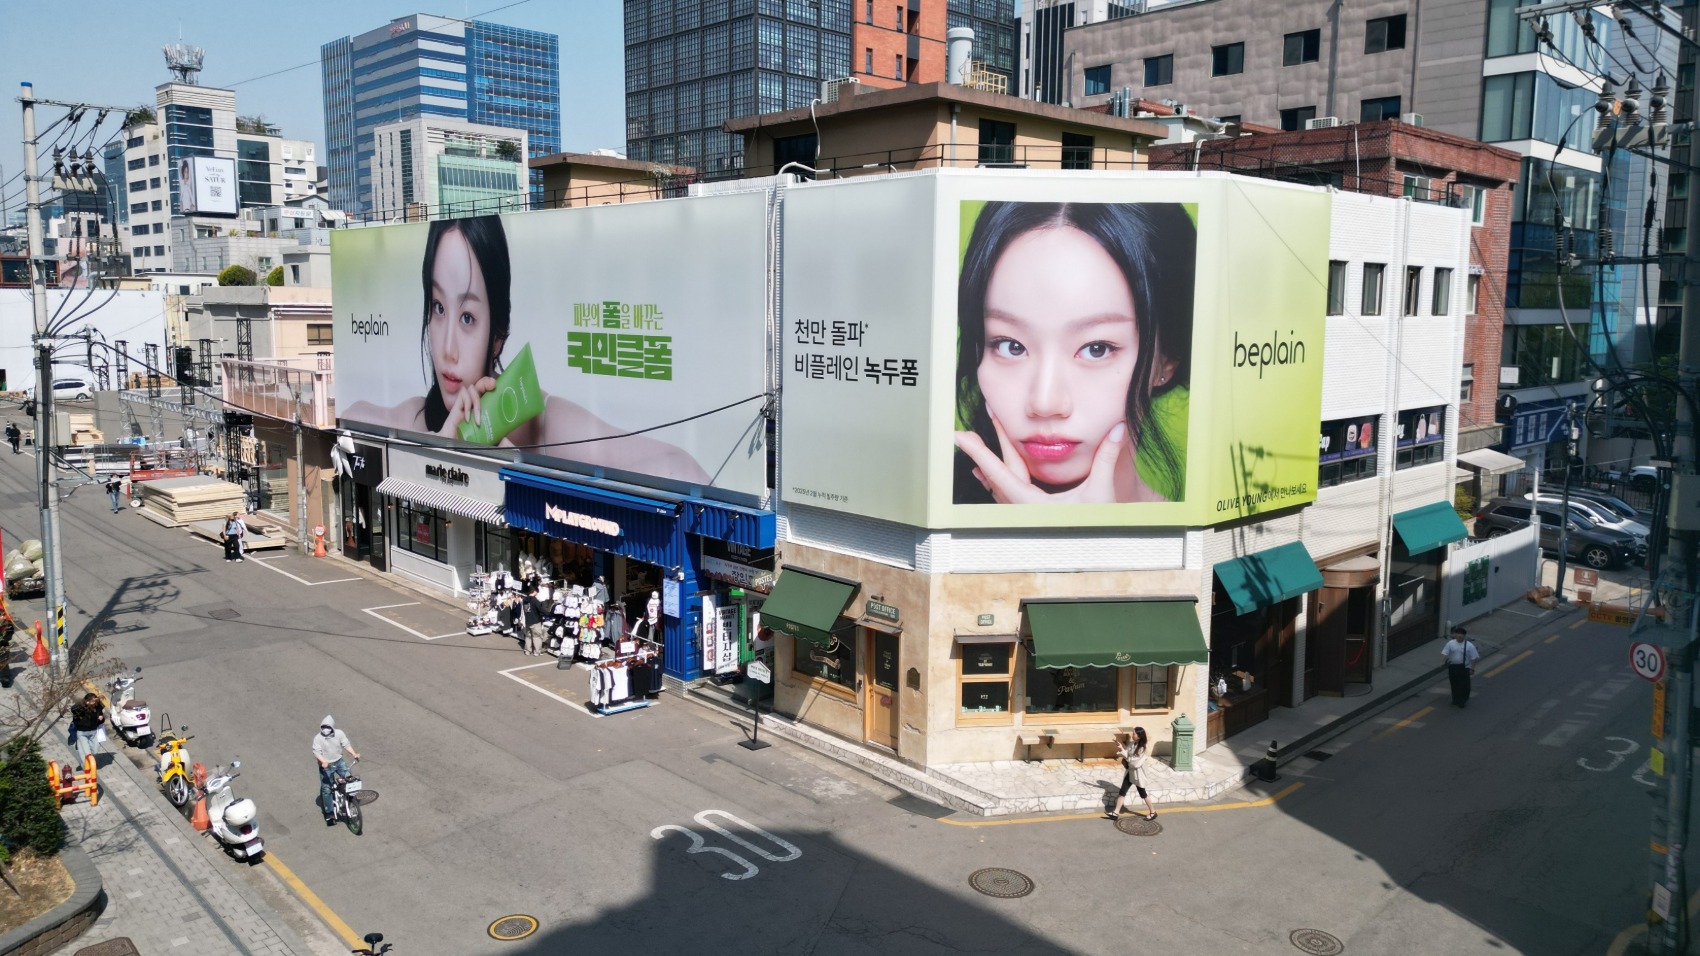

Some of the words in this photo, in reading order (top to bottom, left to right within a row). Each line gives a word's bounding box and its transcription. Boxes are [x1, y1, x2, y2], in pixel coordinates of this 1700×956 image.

[351, 312, 389, 343] beplain
[573, 303, 600, 328] 피부의
[602, 301, 631, 330] 폼을
[633, 303, 664, 331] 바꾸는
[795, 319, 826, 345] 천만
[1233, 330, 1305, 379] beplain
[794, 353, 859, 382] 비플레인
[864, 356, 919, 387] 녹두폼
[425, 463, 447, 478] marie
[448, 466, 470, 484] claire
[1216, 497, 1240, 512] OLIVE
[755, 573, 773, 586] POSTES
[870, 602, 881, 611] POST
[881, 605, 896, 615] OFFICE
[1636, 649, 1658, 672] 30
[650, 809, 803, 881] 30
